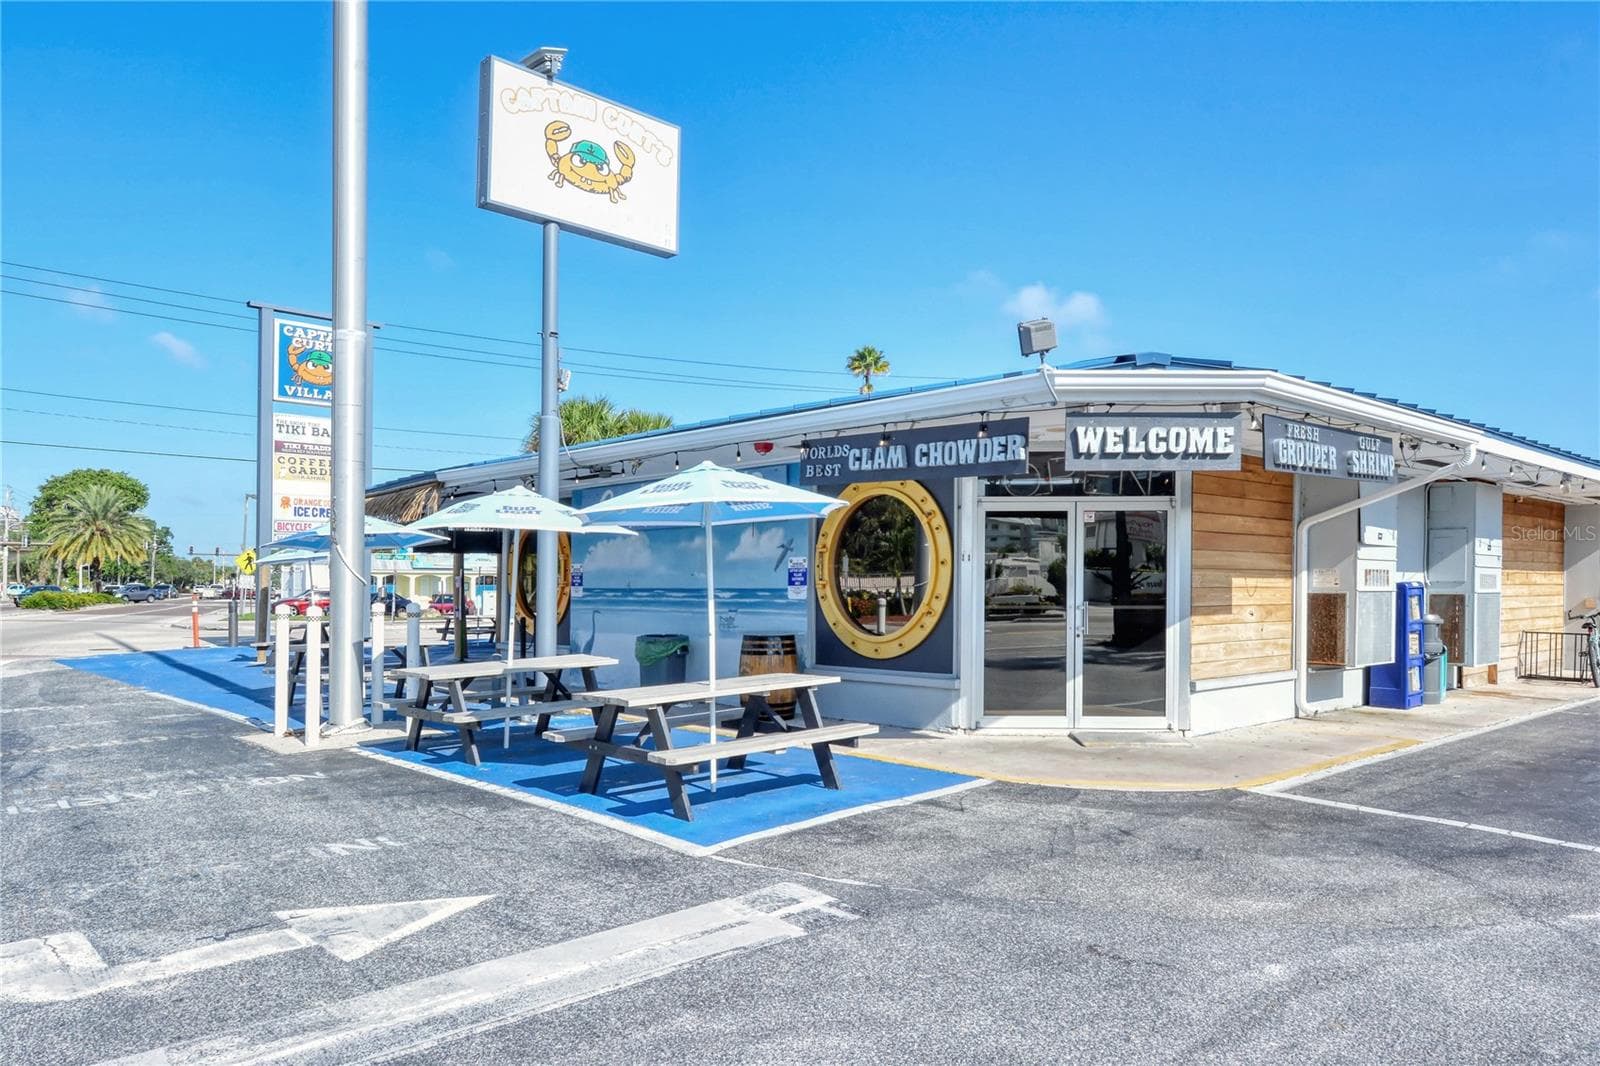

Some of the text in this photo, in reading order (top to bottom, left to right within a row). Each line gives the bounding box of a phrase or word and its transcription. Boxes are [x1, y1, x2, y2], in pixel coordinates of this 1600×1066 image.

[500, 87, 597, 122] CAPTAIN
[276, 424, 306, 436] TIKI
[1073, 426, 1235, 457] WELCOME
[1286, 423, 1320, 442] FRESH
[848, 434, 1026, 471] CLAM CHOWDER
[1277, 438, 1337, 470] GROUPER
[1357, 436, 1381, 452] GULF
[805, 464, 841, 478] BEST
[1350, 450, 1396, 477] SHRIMP
[294, 506, 310, 518] ICE
